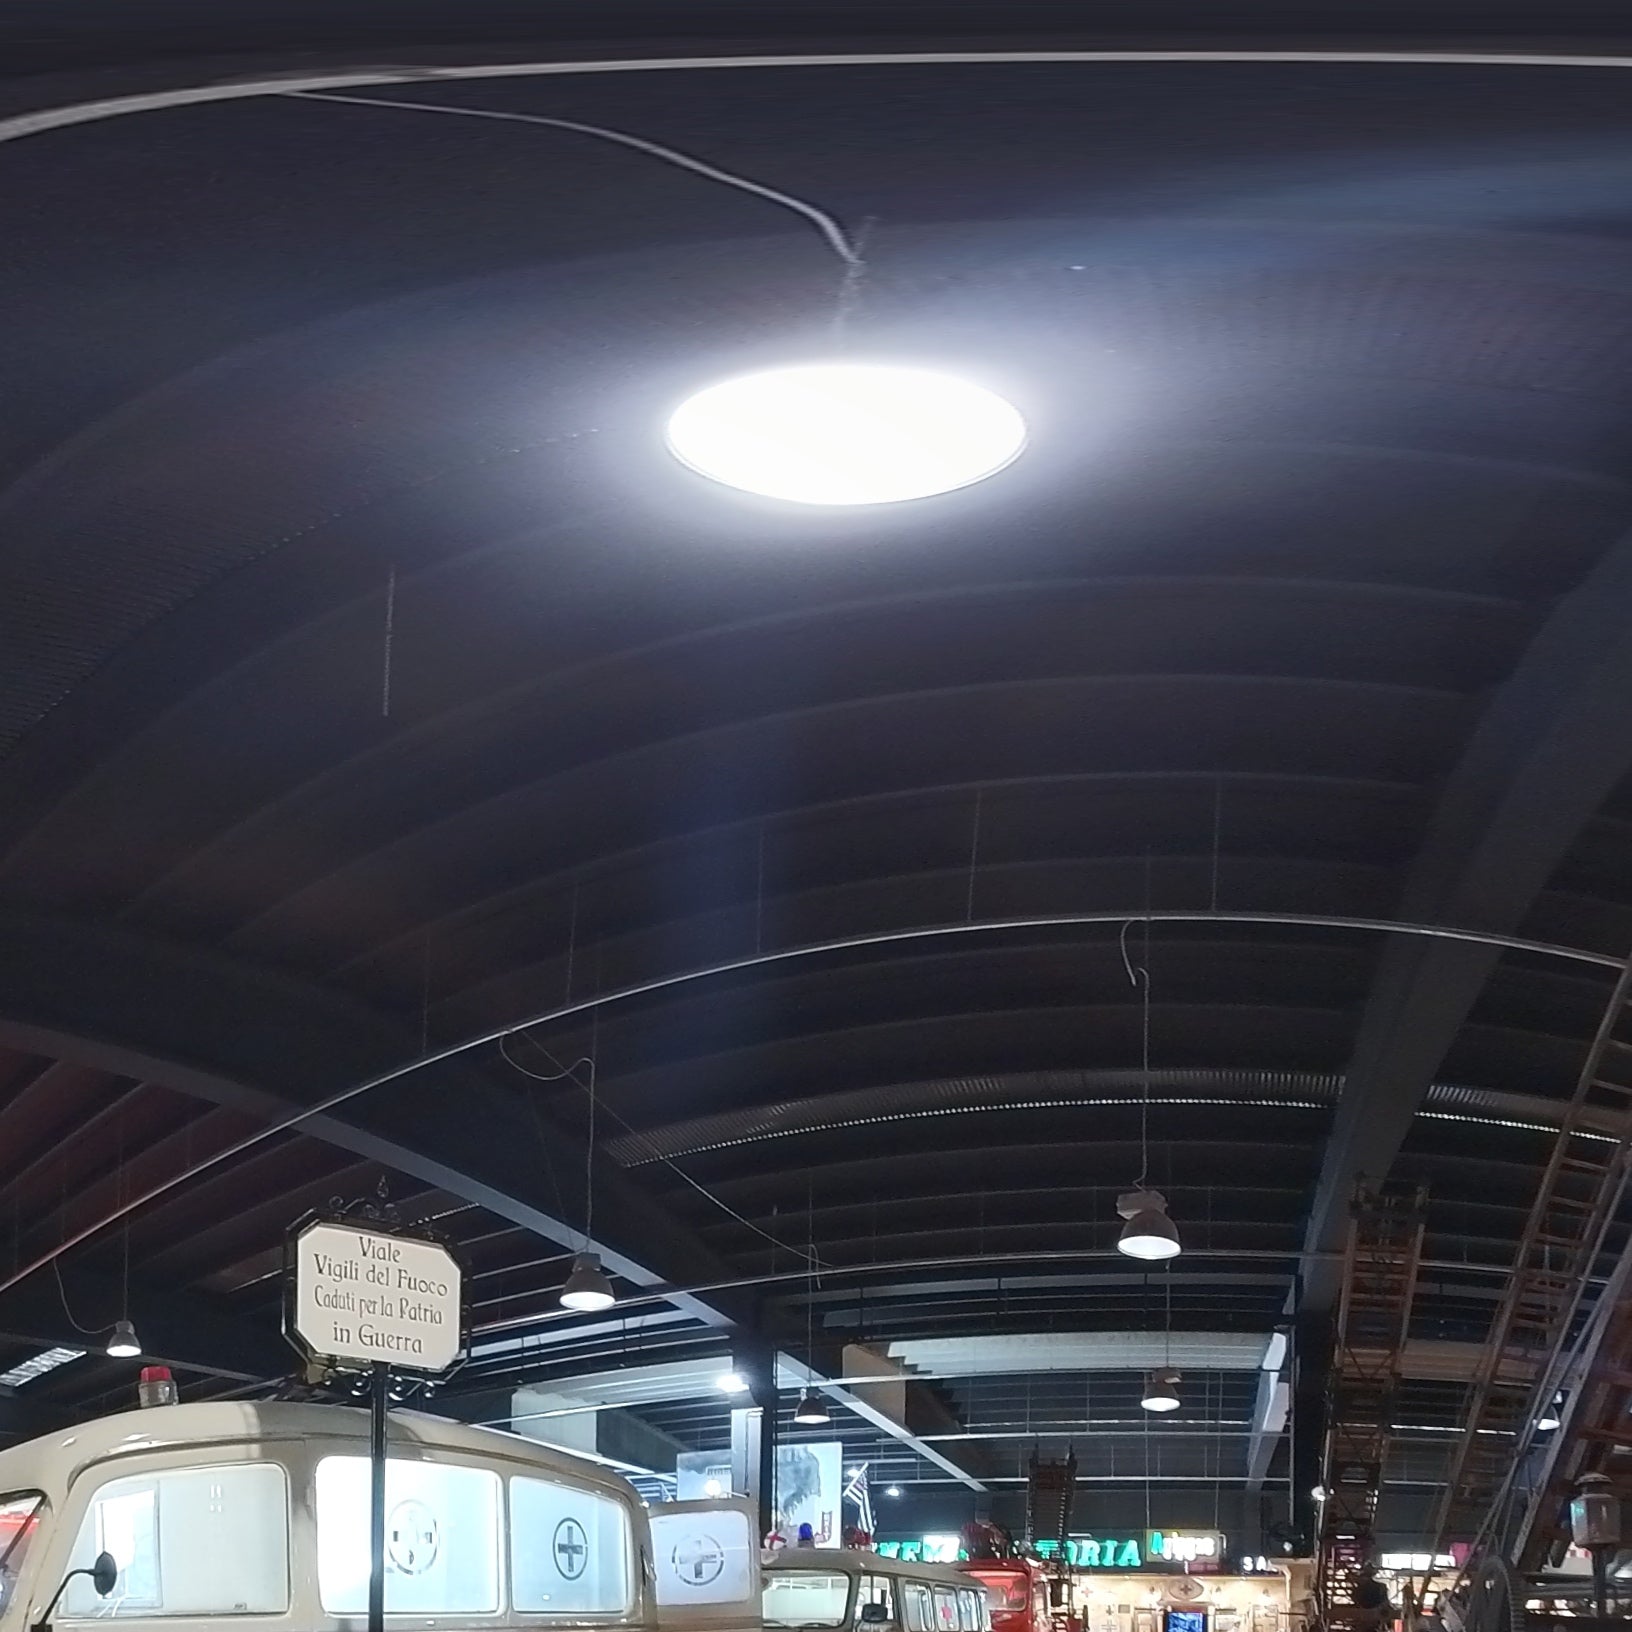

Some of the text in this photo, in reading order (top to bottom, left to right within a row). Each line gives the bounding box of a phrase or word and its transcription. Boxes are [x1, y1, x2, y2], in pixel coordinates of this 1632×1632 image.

[359, 1236, 401, 1263] Viale
[314, 1253, 448, 1297] Vigili del Fuoco
[314, 1285, 442, 1325] Caduti per la Patria
[333, 1321, 422, 1353] in Guerra
